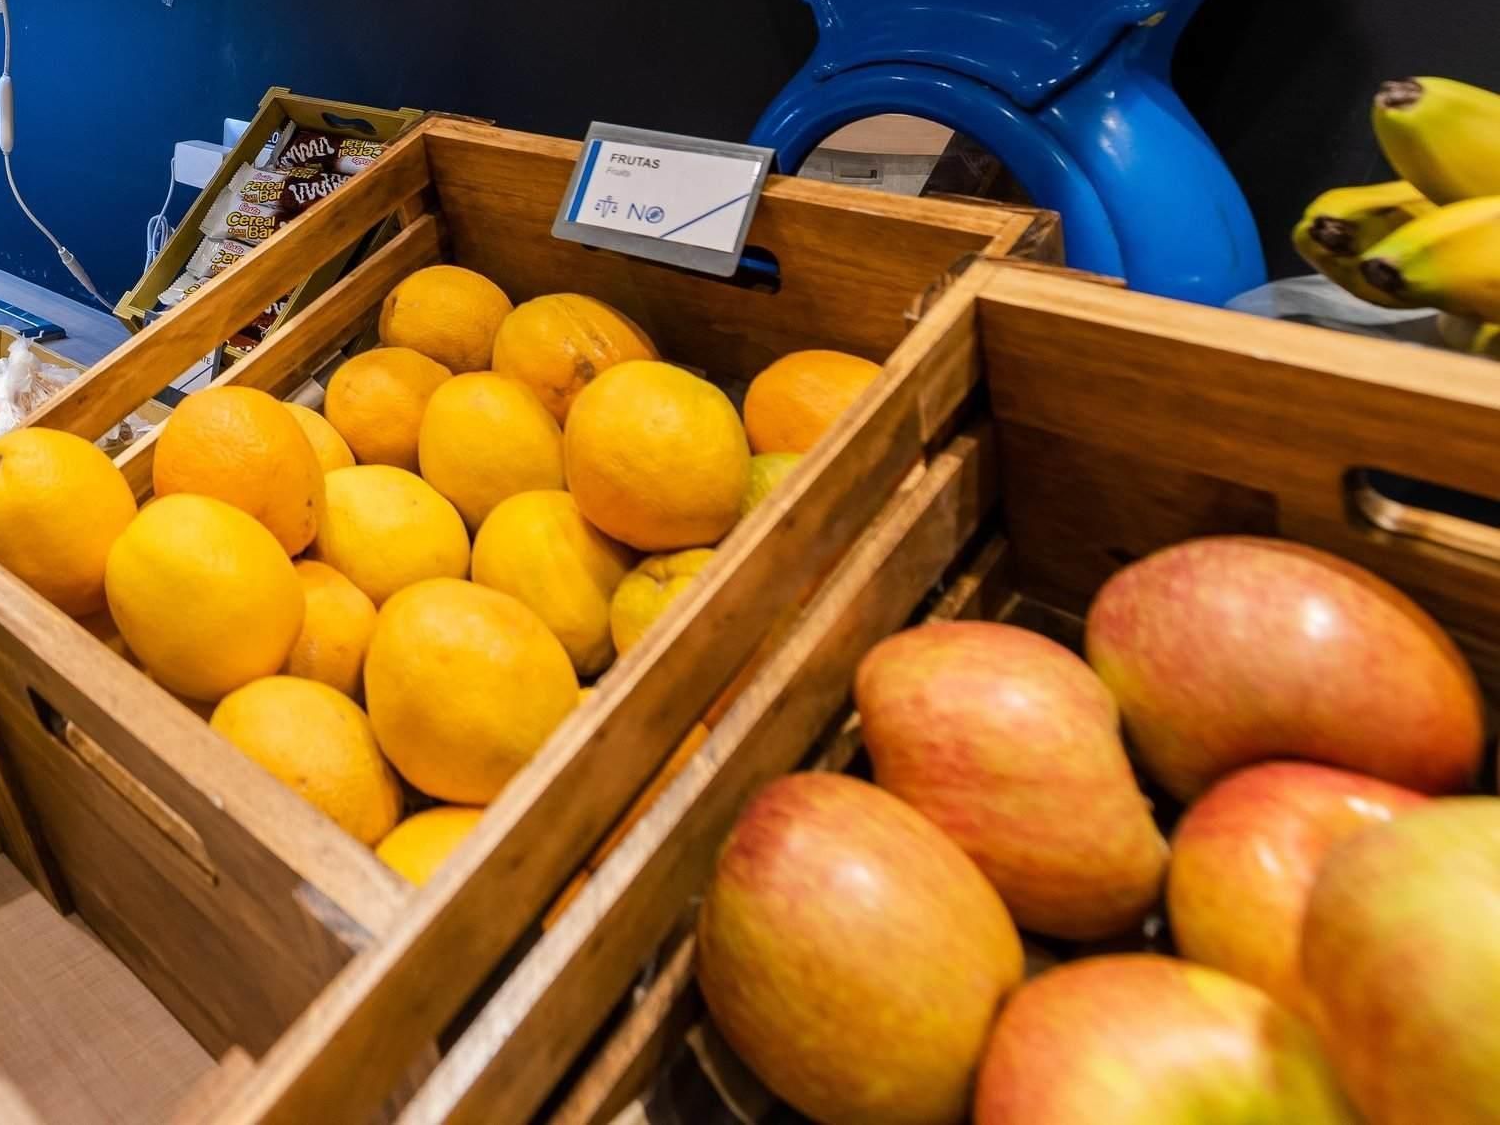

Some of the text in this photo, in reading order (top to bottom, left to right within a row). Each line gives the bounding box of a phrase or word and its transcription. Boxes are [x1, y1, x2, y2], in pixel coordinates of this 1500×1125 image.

[610, 153, 661, 169] FRUTAS
[241, 181, 286, 193] Cereal
[258, 188, 283, 204] Bar
[226, 211, 276, 227] Cereal
[247, 225, 276, 239] Bar
